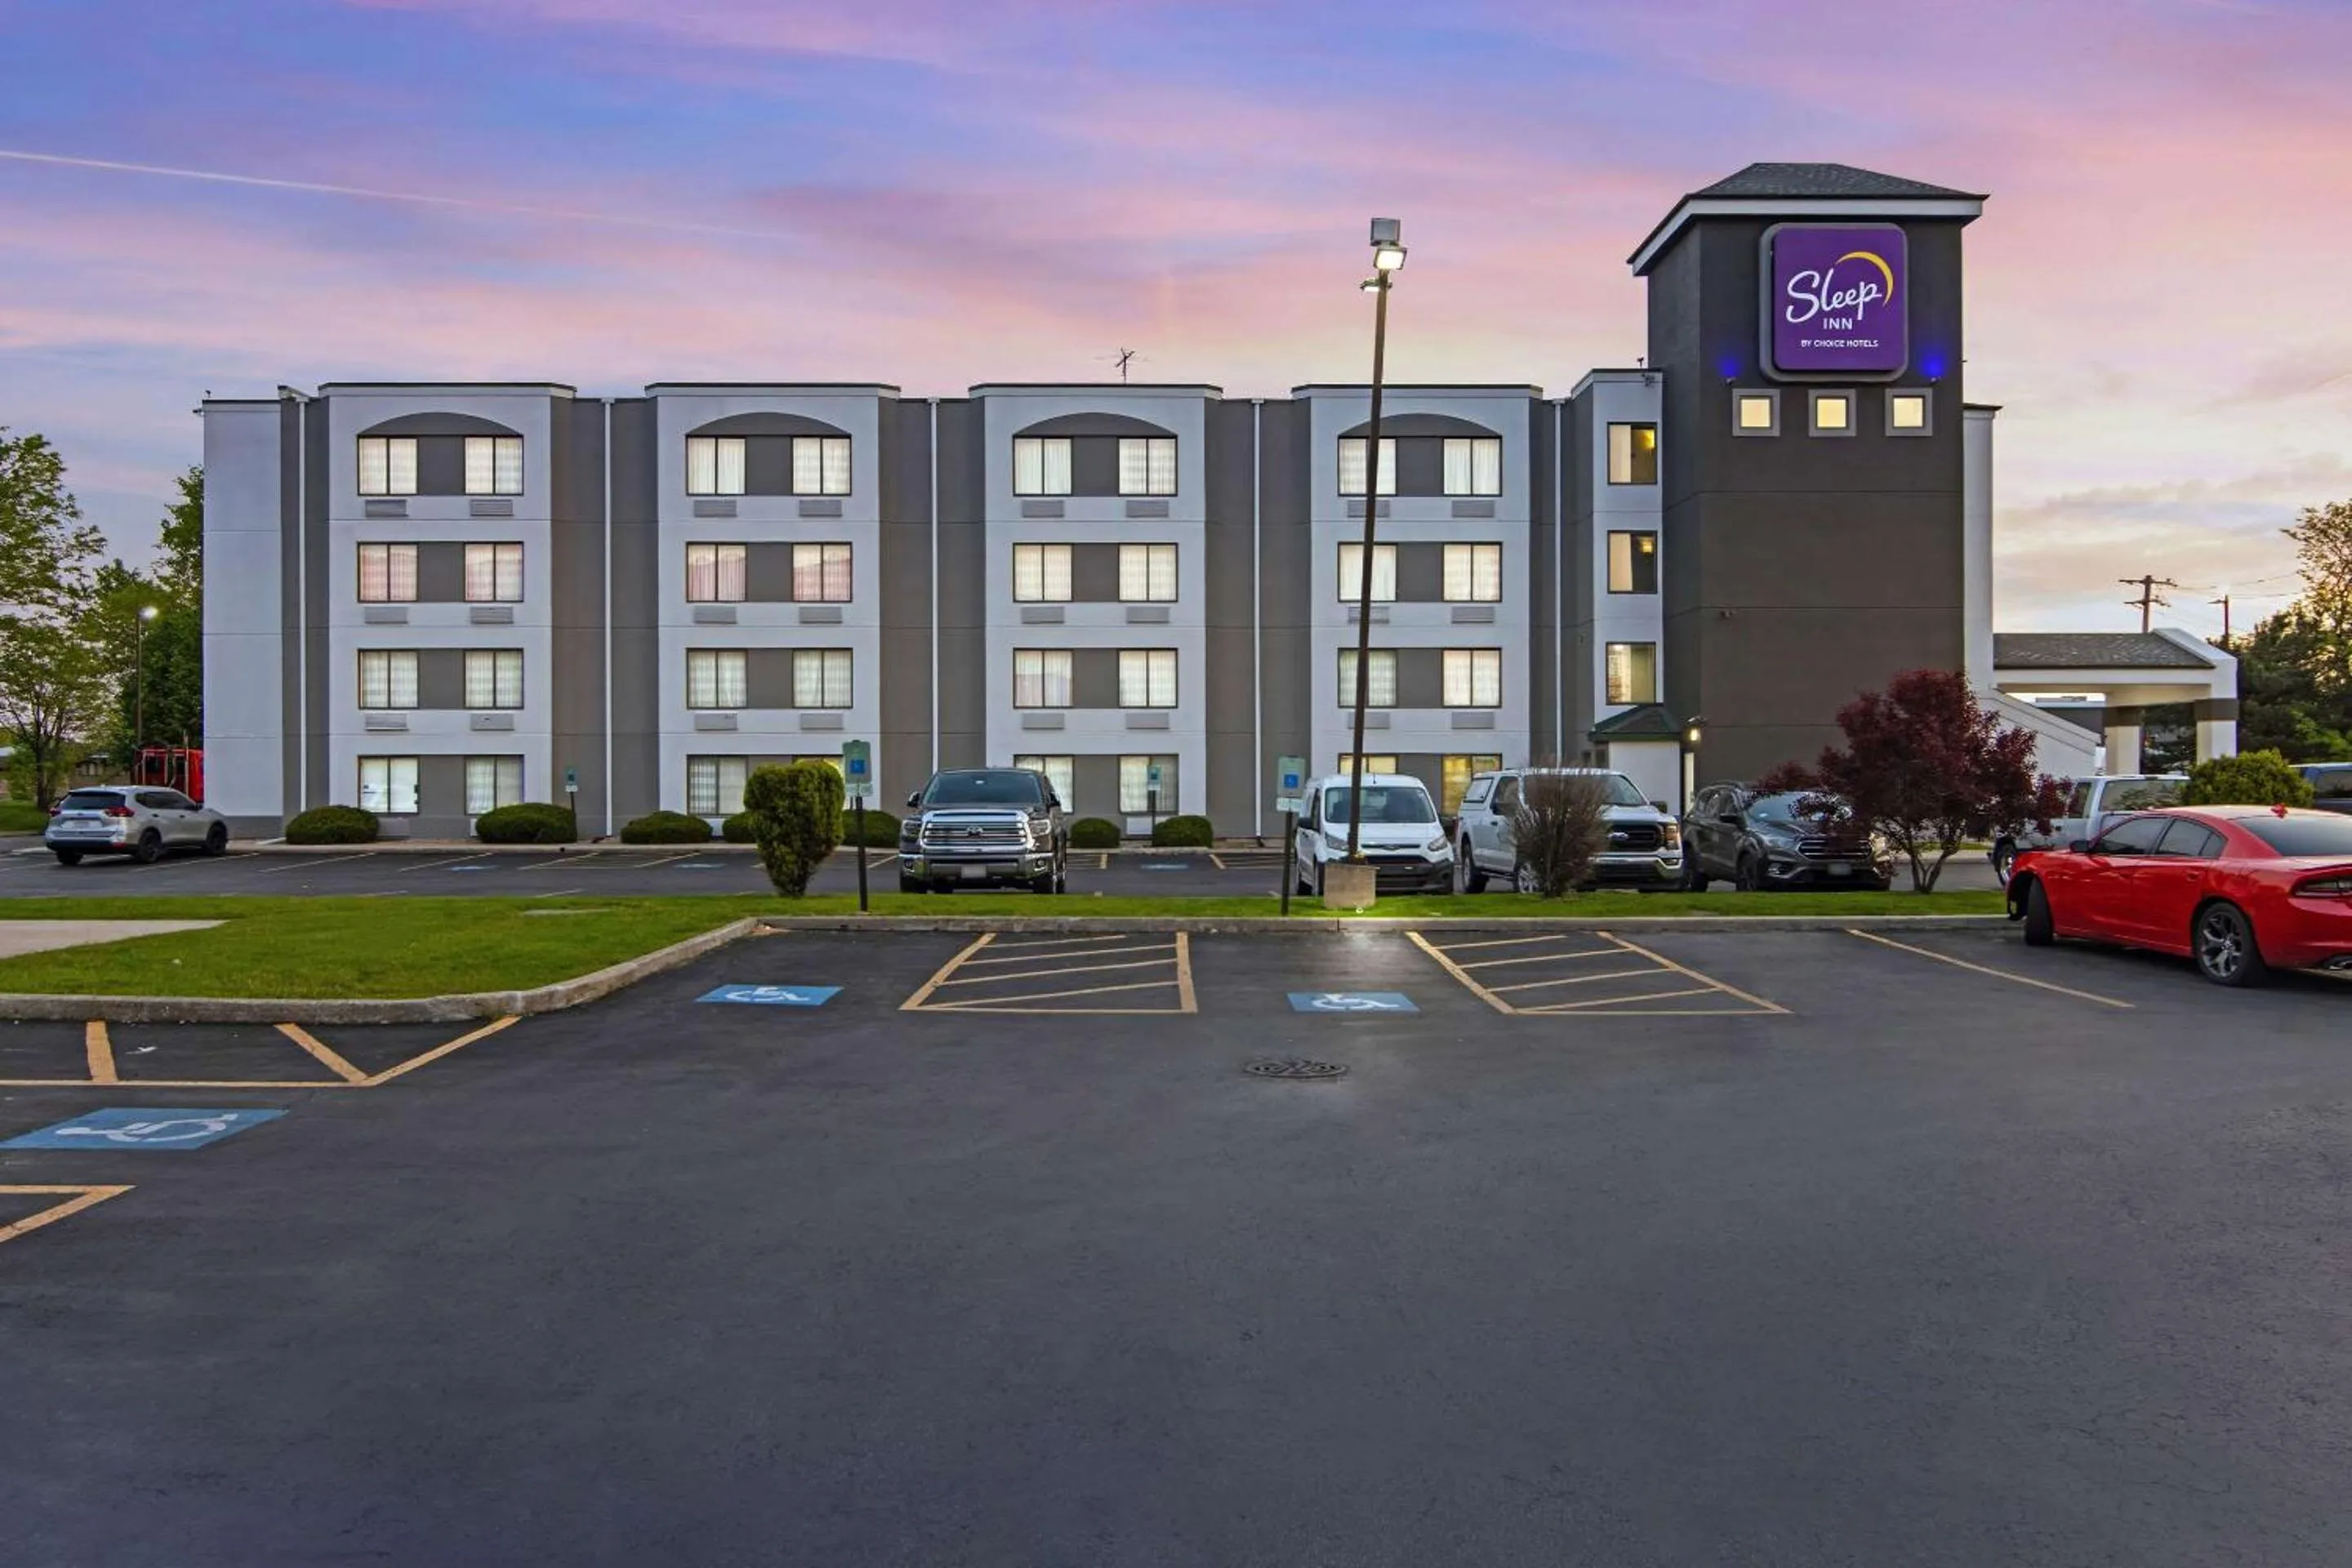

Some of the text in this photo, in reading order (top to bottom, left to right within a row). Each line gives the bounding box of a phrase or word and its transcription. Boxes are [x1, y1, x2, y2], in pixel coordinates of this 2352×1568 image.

[1786, 268, 1882, 323] Sleep
[1823, 318, 1853, 330] INN
[1801, 339, 1879, 348] BY CHOICE HOTELS
